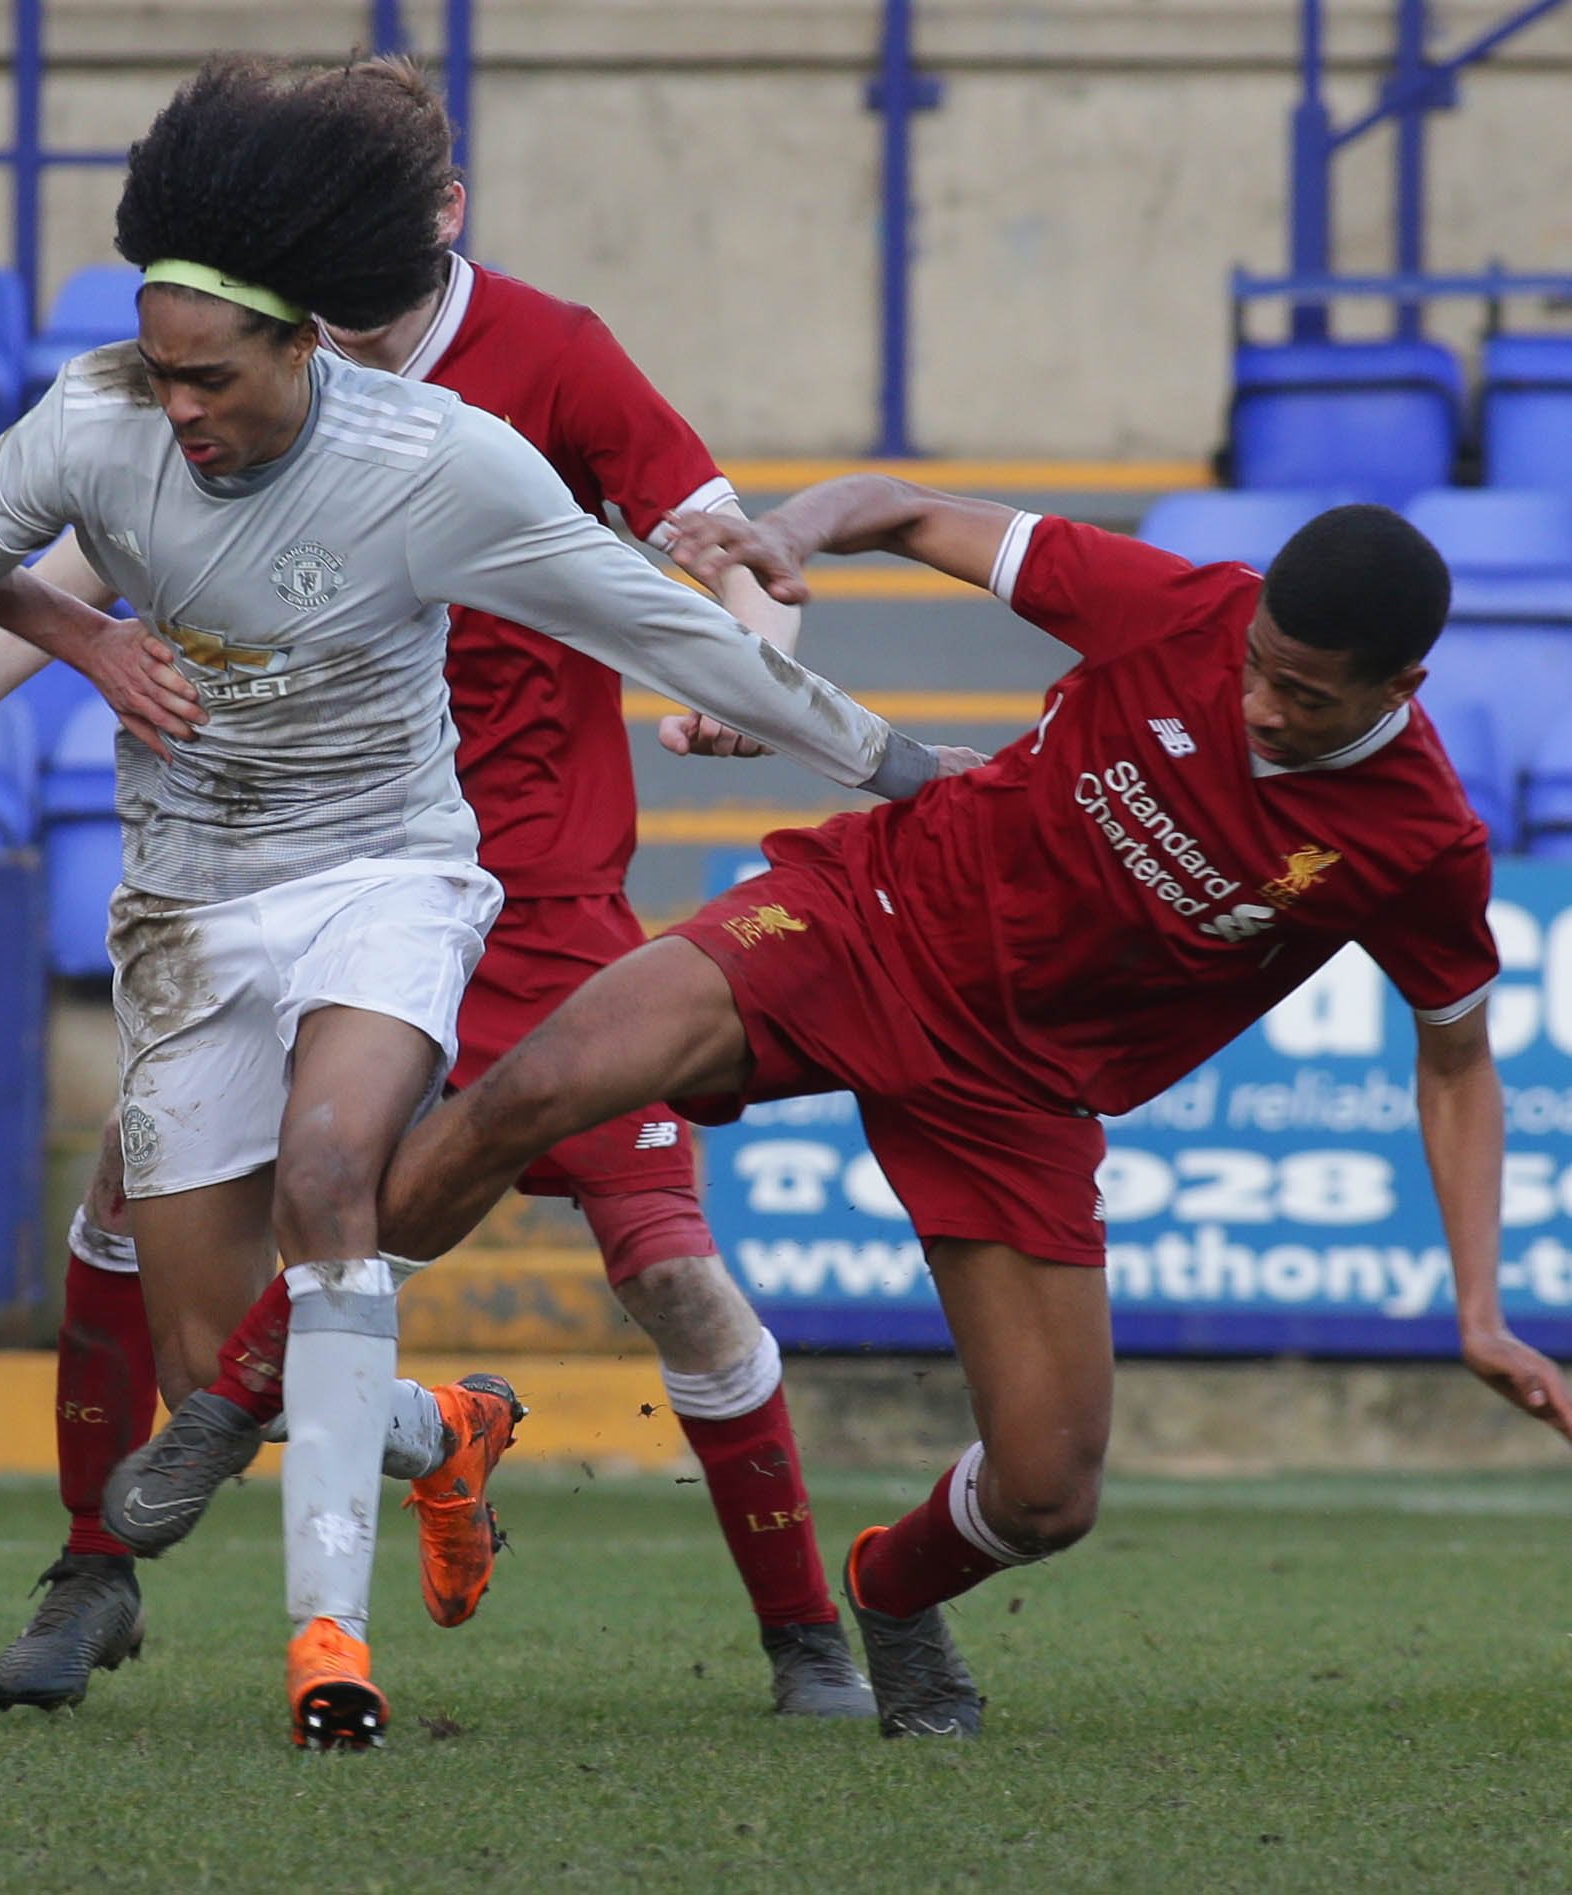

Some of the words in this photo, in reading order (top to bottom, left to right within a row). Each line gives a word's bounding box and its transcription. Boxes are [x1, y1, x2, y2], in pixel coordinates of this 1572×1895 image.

[1074, 772, 1210, 917] Chartered
[1104, 760, 1241, 900] Standard
[1227, 1066, 1420, 1132] reliab
